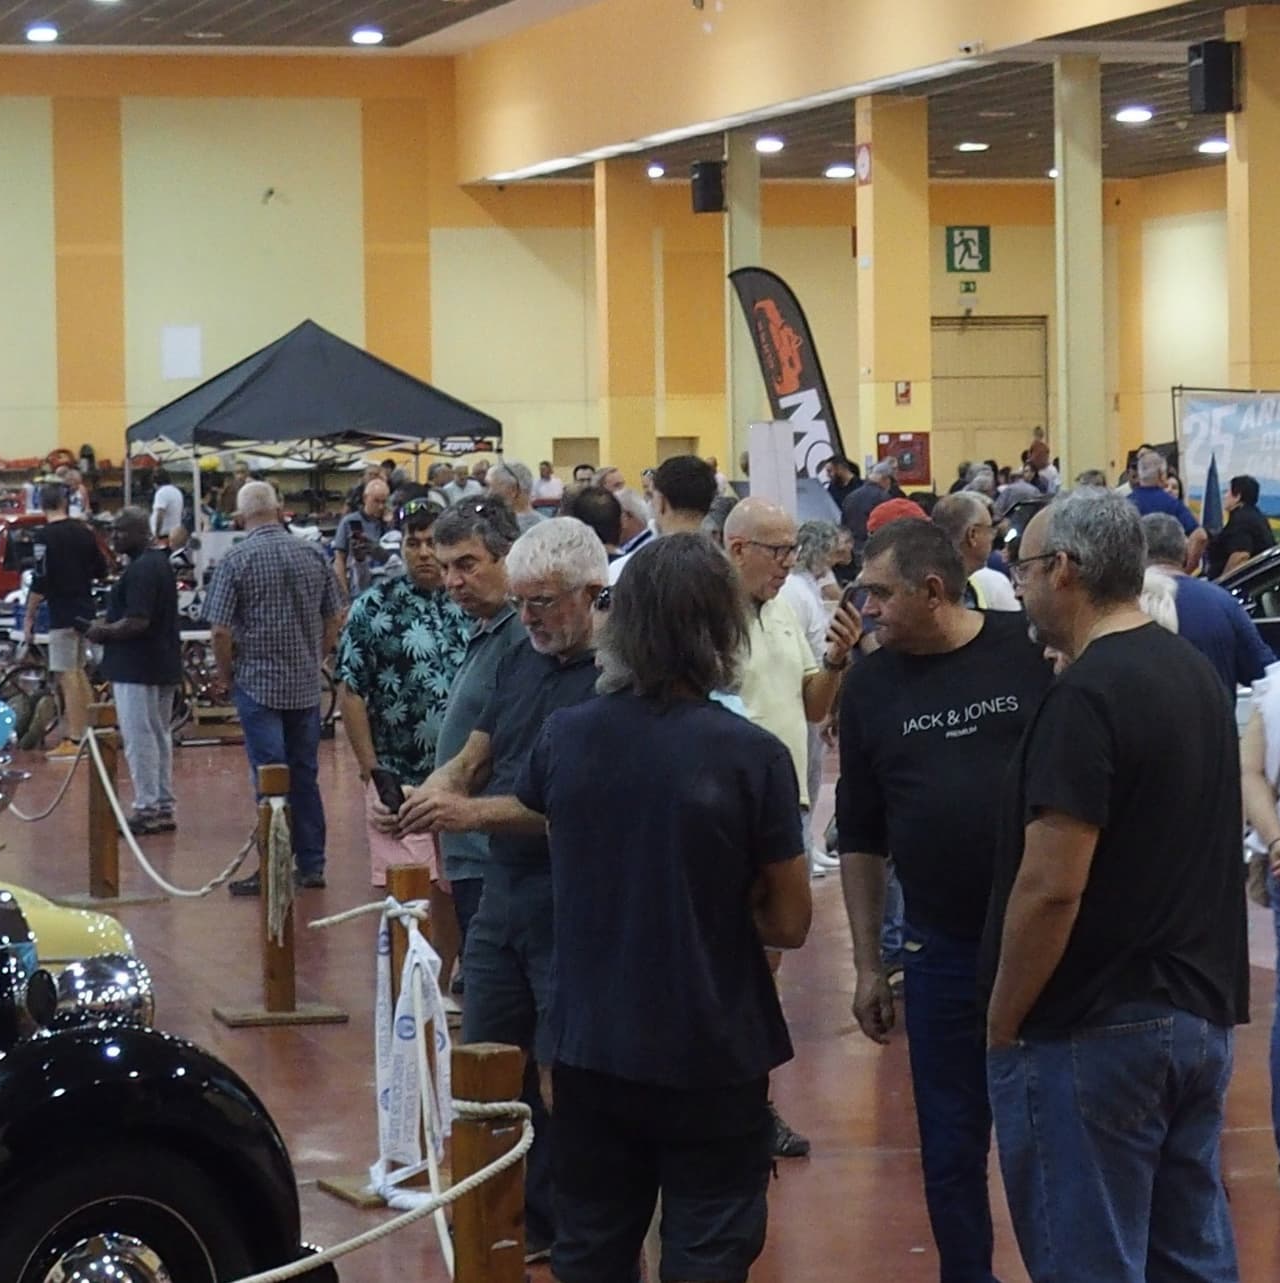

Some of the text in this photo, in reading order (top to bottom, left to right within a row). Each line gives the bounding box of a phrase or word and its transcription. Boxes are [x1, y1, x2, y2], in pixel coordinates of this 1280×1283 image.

[1182, 403, 1239, 474] 25
[902, 695, 1019, 736] JACK & JONES
